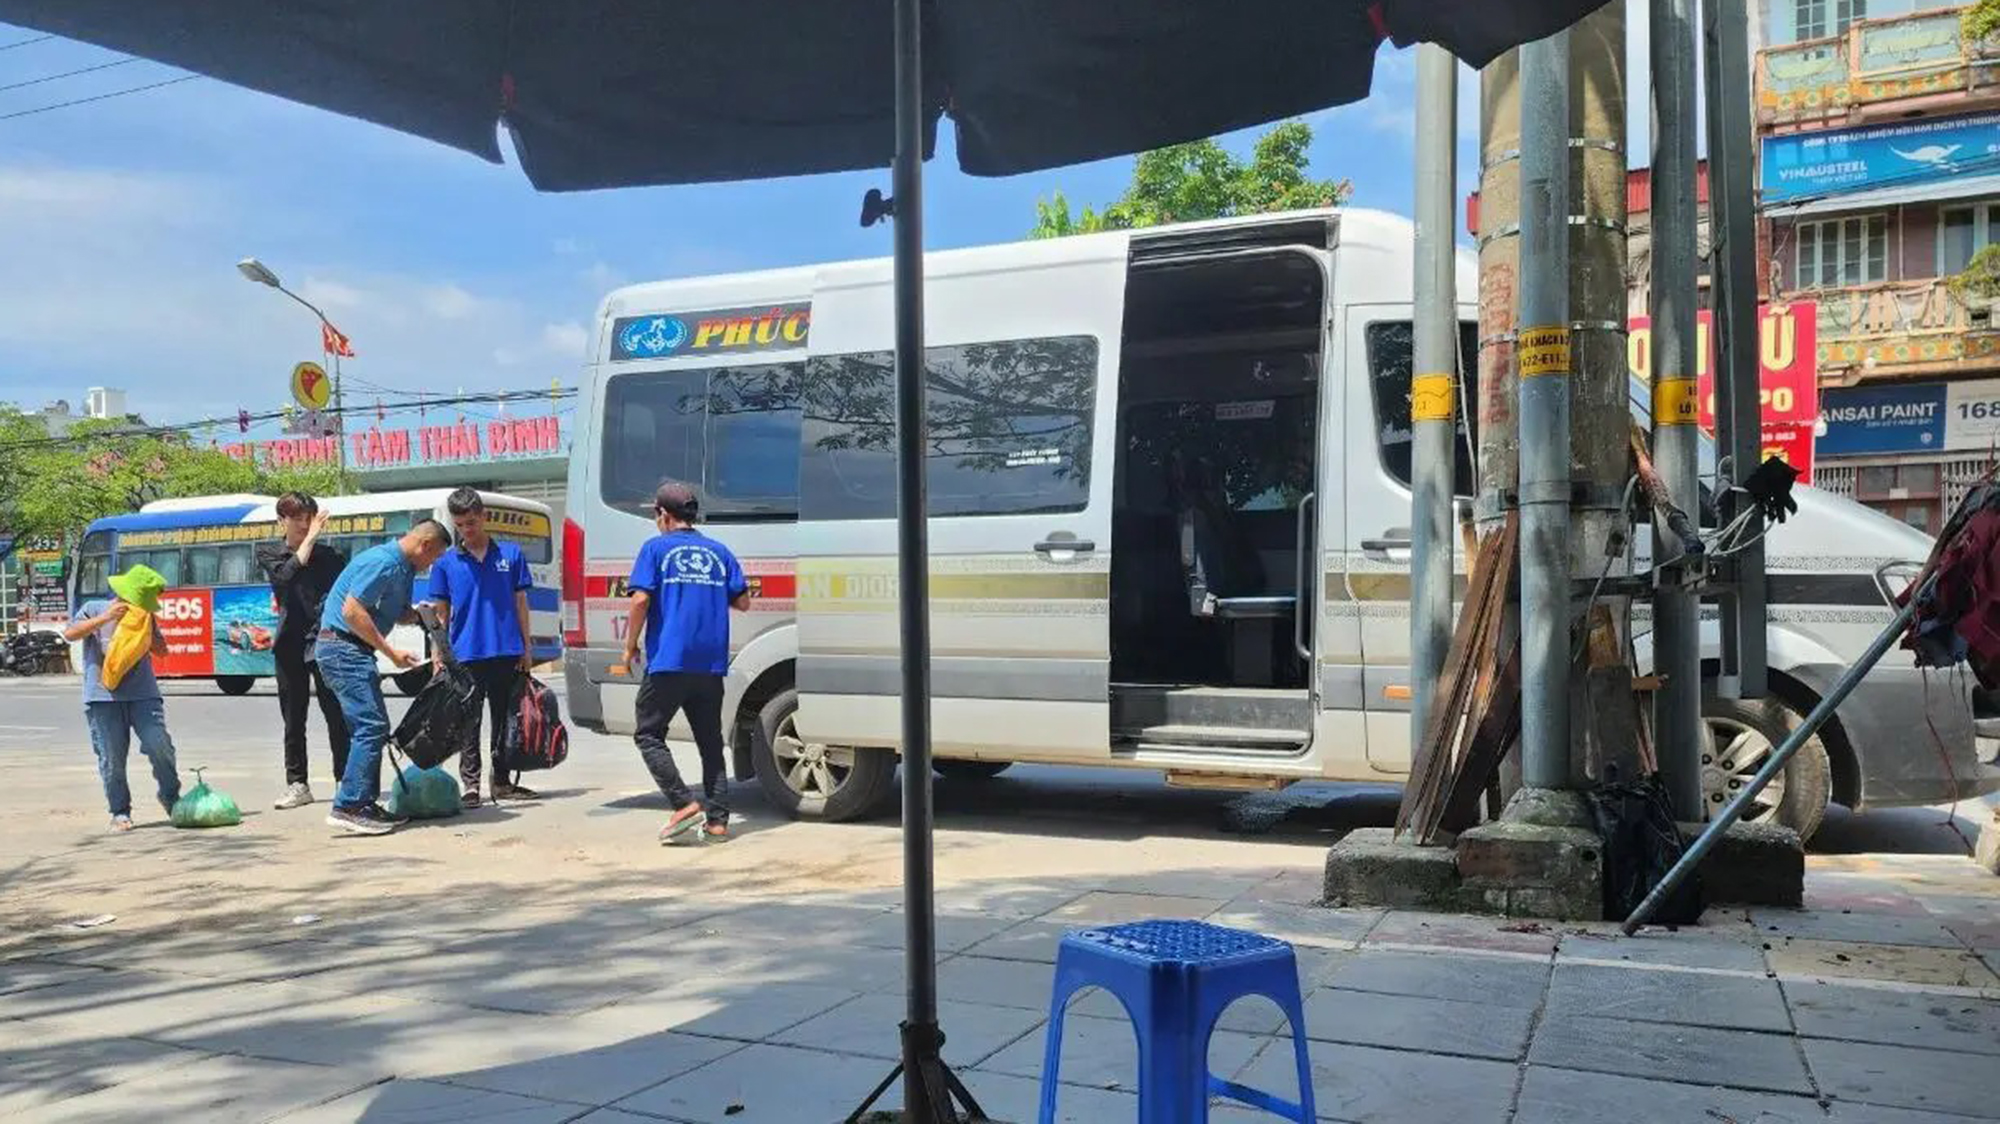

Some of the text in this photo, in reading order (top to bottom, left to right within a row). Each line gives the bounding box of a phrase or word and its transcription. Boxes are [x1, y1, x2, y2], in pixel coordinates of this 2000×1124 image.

[1779, 159, 1868, 181] VINAUSTEEL
[1821, 402, 1936, 423] ANSAI PAINT
